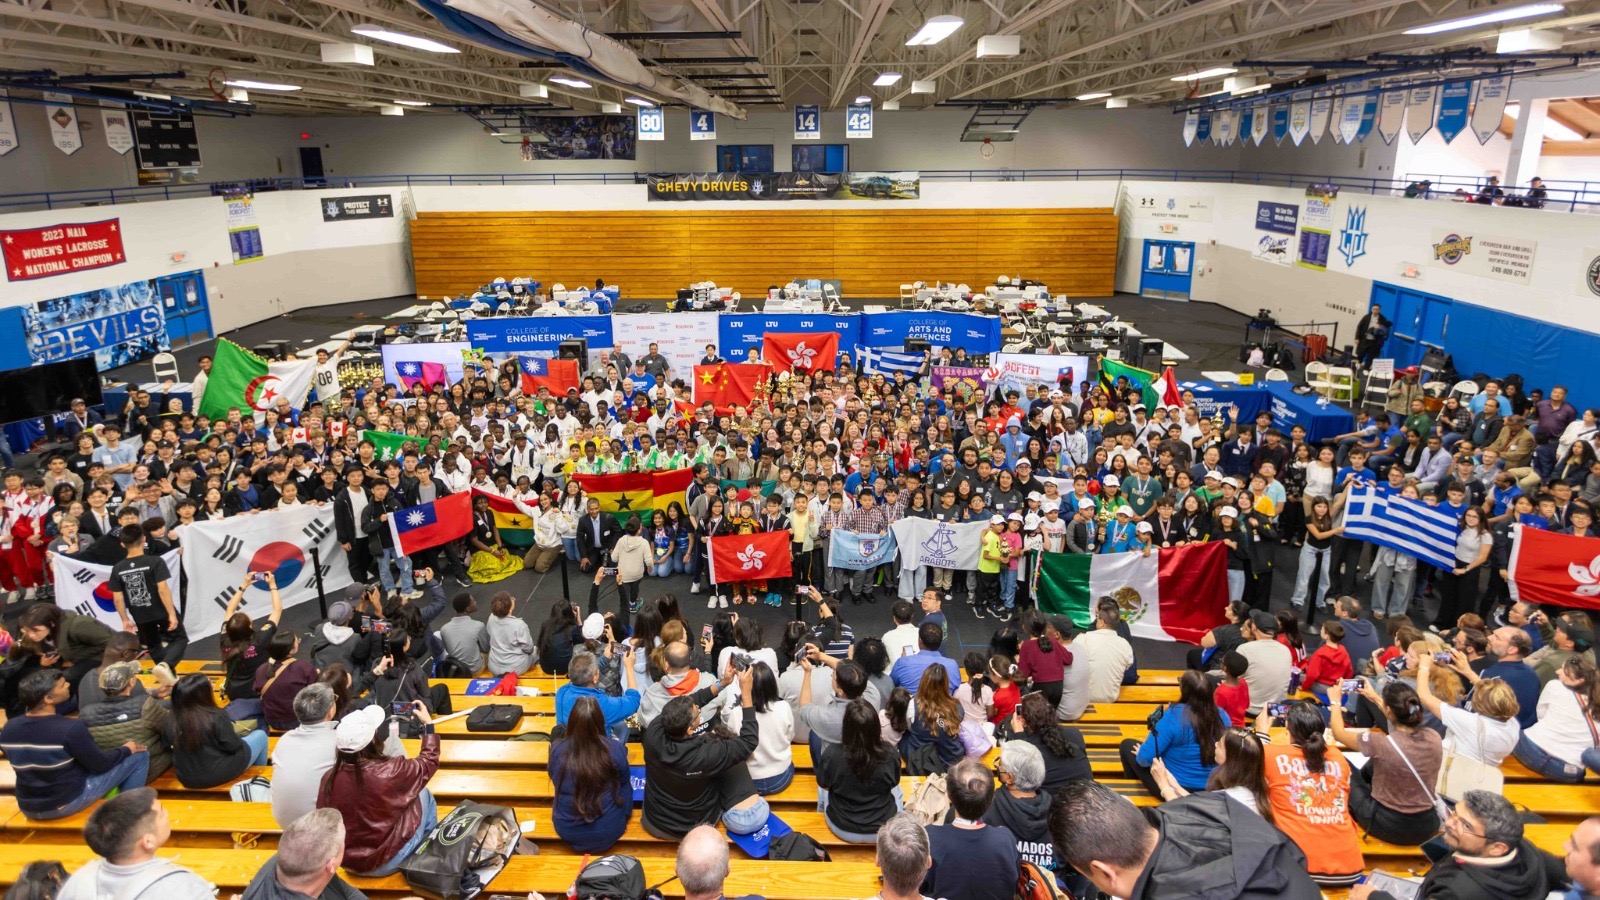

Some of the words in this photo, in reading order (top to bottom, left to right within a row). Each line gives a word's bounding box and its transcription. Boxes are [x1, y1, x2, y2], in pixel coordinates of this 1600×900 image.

[641, 115, 660, 131] 80
[697, 115, 708, 130] 4
[798, 114, 815, 130] 14
[849, 114, 870, 130] 42
[58, 140, 76, 149] 1951
[656, 182, 699, 193] CHEVY
[701, 181, 748, 192] DRIVES
[343, 201, 370, 209] PROTECT
[42, 229, 65, 242] 2023
[66, 227, 88, 238] NAIA
[22, 245, 64, 260] WOMEN'S
[66, 239, 109, 254] LACROSSE
[25, 260, 71, 276] NATIONAL
[72, 253, 113, 268] CHAMPION
[35, 308, 162, 361] DEVILS
[506, 327, 539, 335] COLLEGE
[908, 325, 931, 333] ARTS
[932, 326, 952, 334] AND
[317, 370, 332, 386] 08
[919, 555, 957, 567] ARABOTS
